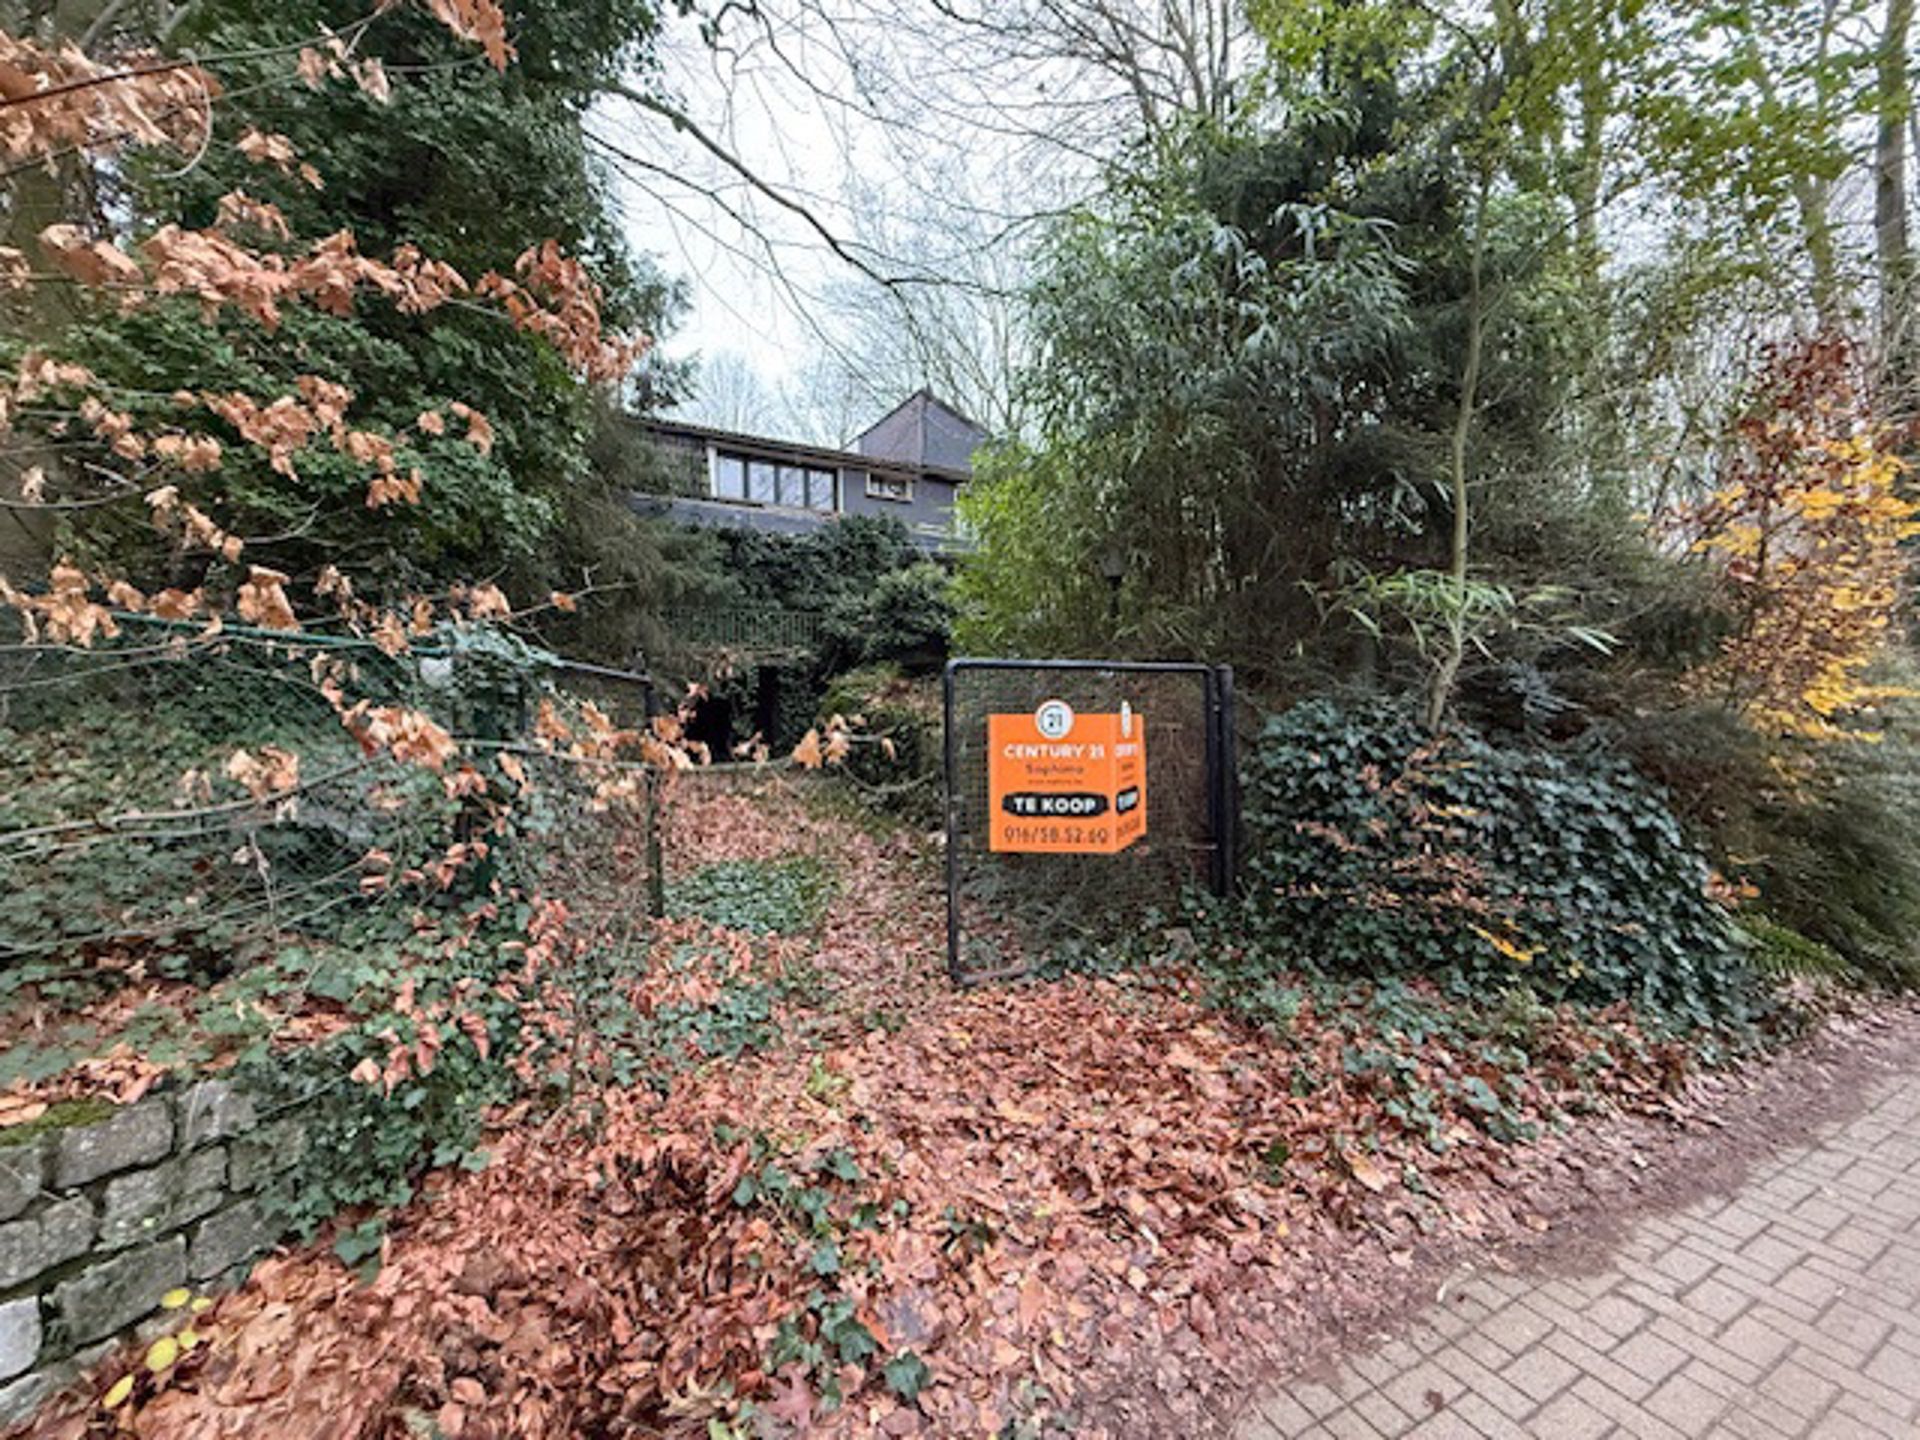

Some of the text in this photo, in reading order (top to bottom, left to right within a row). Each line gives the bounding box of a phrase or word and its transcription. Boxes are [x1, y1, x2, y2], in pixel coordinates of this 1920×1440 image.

[1003, 743, 1086, 759] CENTURY
[1089, 743, 1105, 759] 21
[1013, 797, 1097, 813] TE KOOP
[1004, 825, 1108, 844] 016/58.52.60
